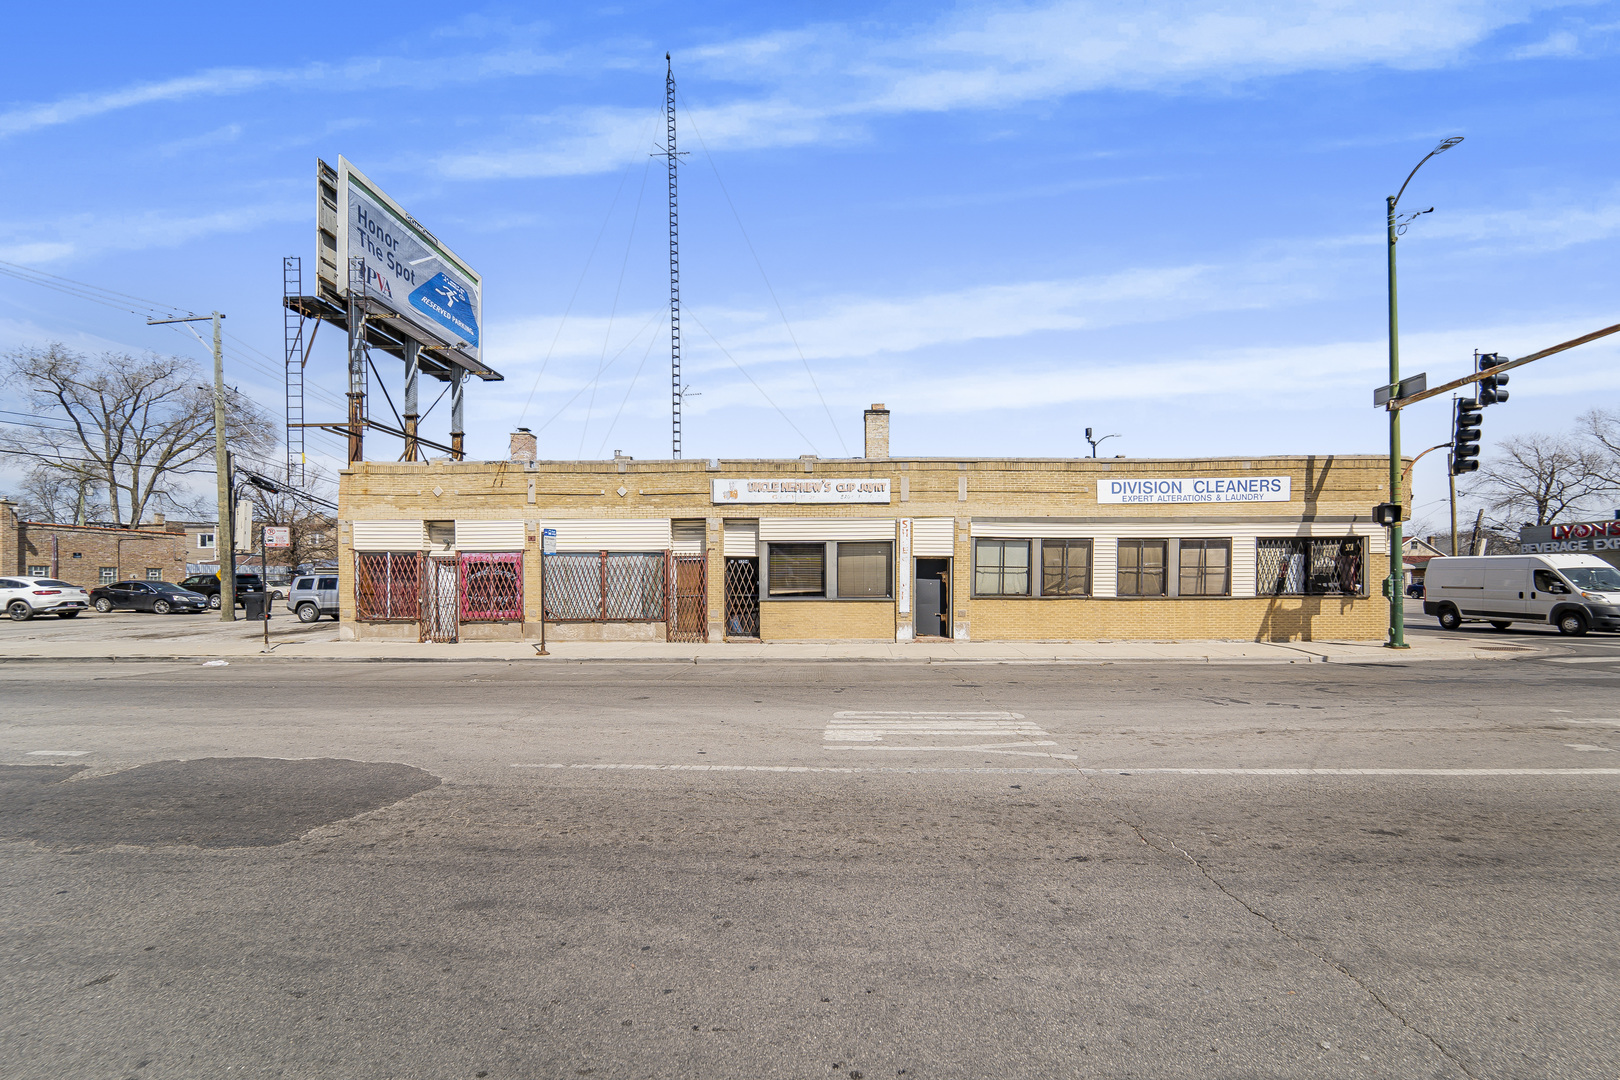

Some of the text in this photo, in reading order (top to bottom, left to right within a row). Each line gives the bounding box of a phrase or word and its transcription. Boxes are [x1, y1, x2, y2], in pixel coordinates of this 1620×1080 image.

[357, 204, 399, 252] Honor
[357, 226, 383, 262] The
[386, 251, 416, 286] Spot
[366, 265, 393, 299] PVA
[421, 296, 474, 336] RESERVED PARKING
[748, 479, 887, 493] UNCLE NEPHEW'S CLIP JOYNT
[1111, 479, 1281, 495] DIVISION CLEANERS
[1122, 493, 1264, 503] EXPERT ALTERATIONS & LAUNDRY
[1551, 522, 1620, 539] LYON'S
[1521, 541, 1588, 554] BEVERAGE
